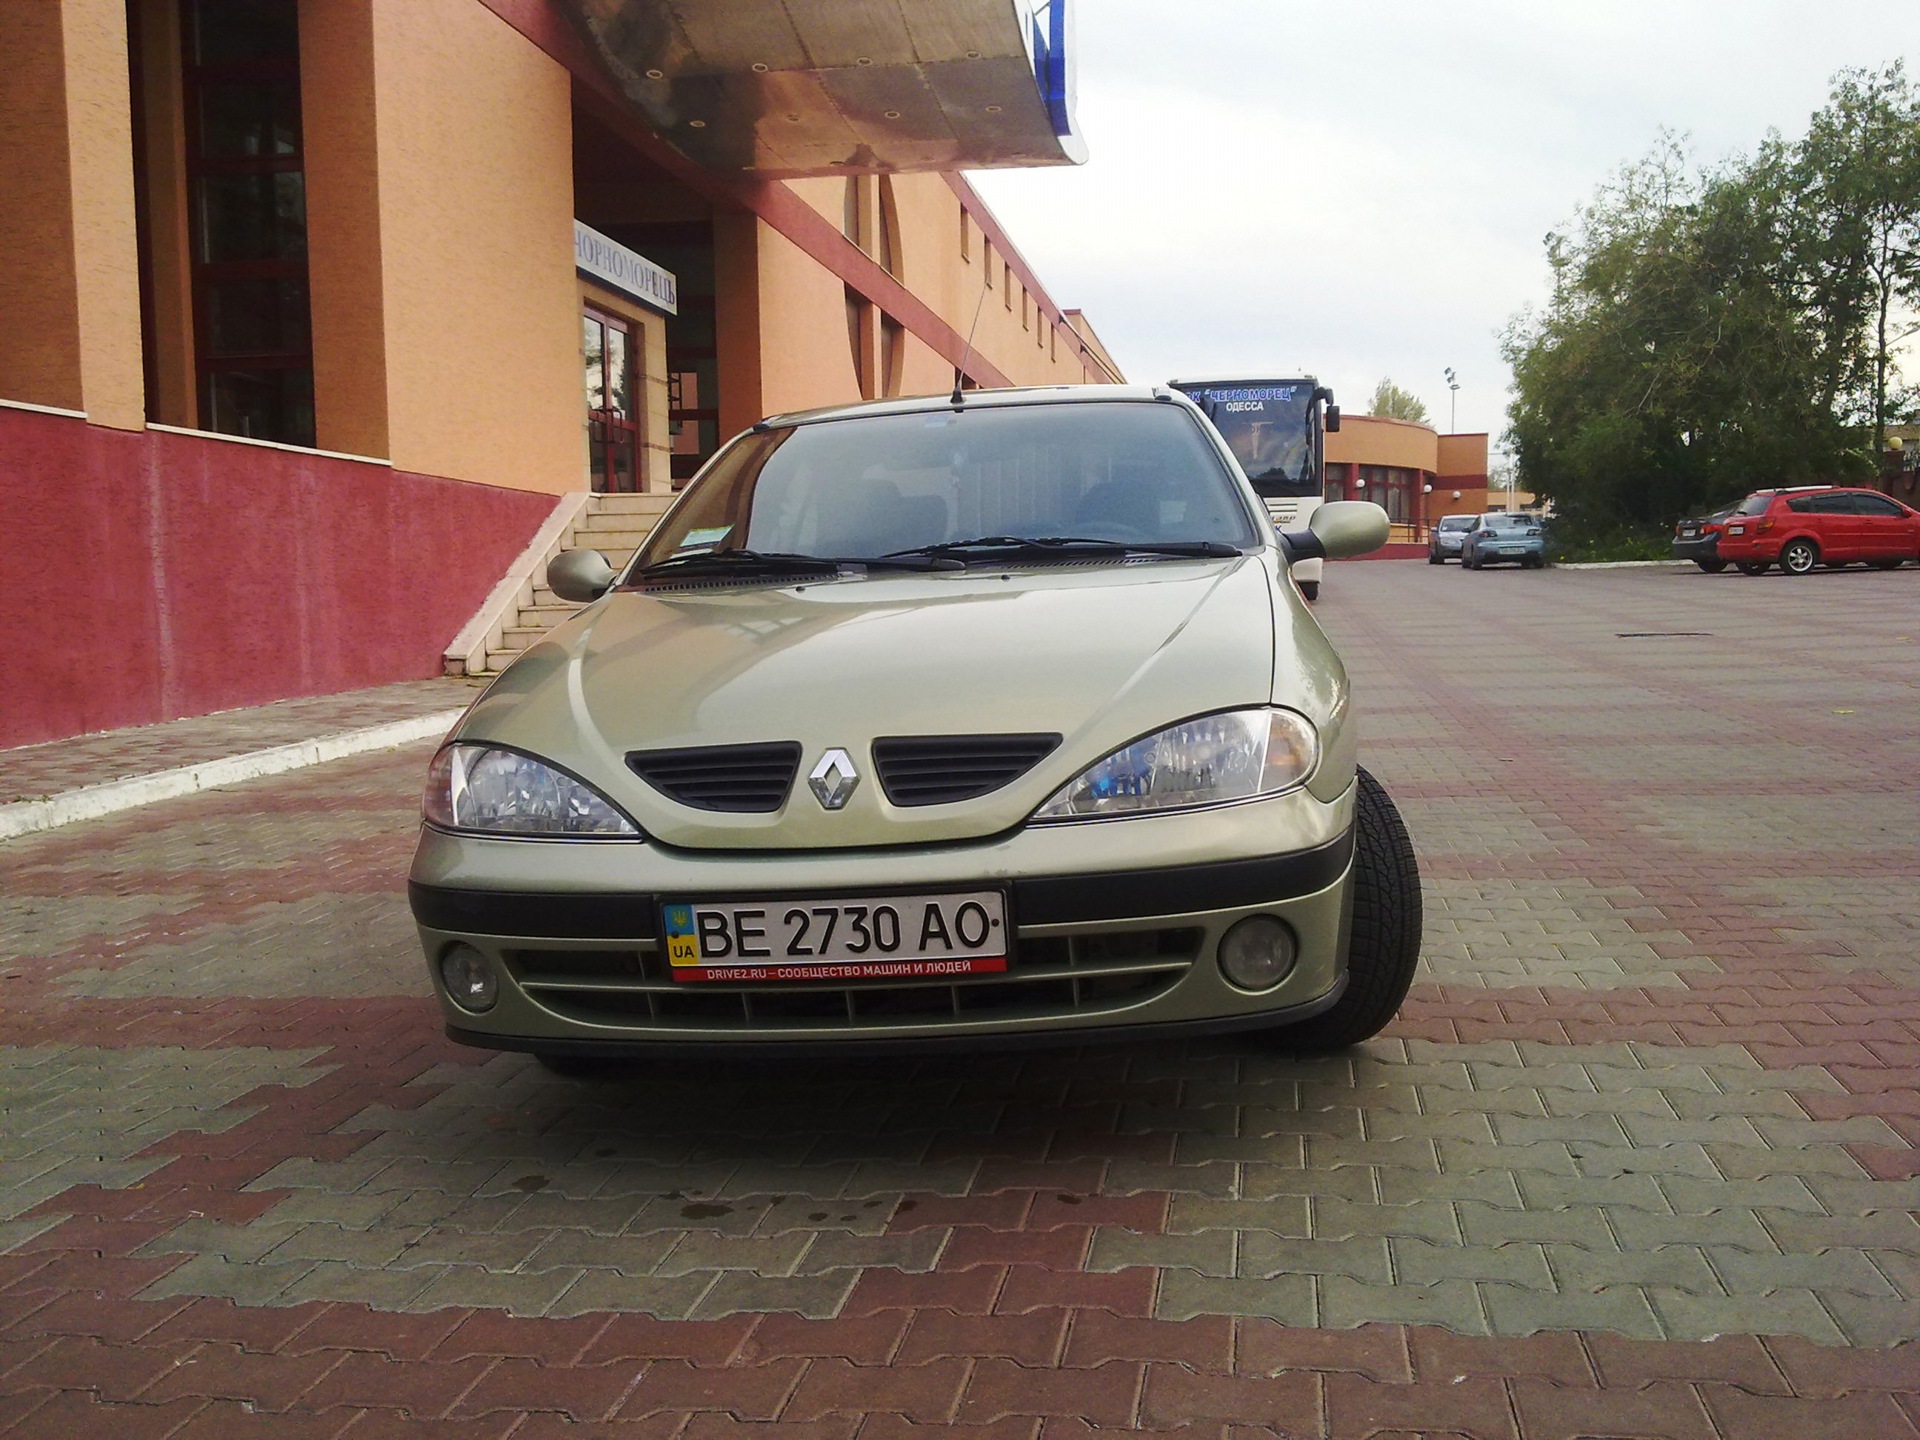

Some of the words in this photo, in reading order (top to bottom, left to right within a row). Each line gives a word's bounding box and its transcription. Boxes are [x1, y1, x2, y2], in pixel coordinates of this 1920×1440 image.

[1226, 401, 1264, 412] ОДЕССА
[696, 909, 771, 957] BE
[784, 905, 901, 956] 2730
[918, 901, 990, 951] AO
[673, 945, 695, 958] UA
[707, 968, 767, 980] DRIVE2.RU
[777, 966, 861, 978] СООБЩЕСТВО
[863, 963, 911, 976] МАШИН
[914, 963, 923, 974] И
[926, 960, 971, 974] ЛЮДЕЙ
